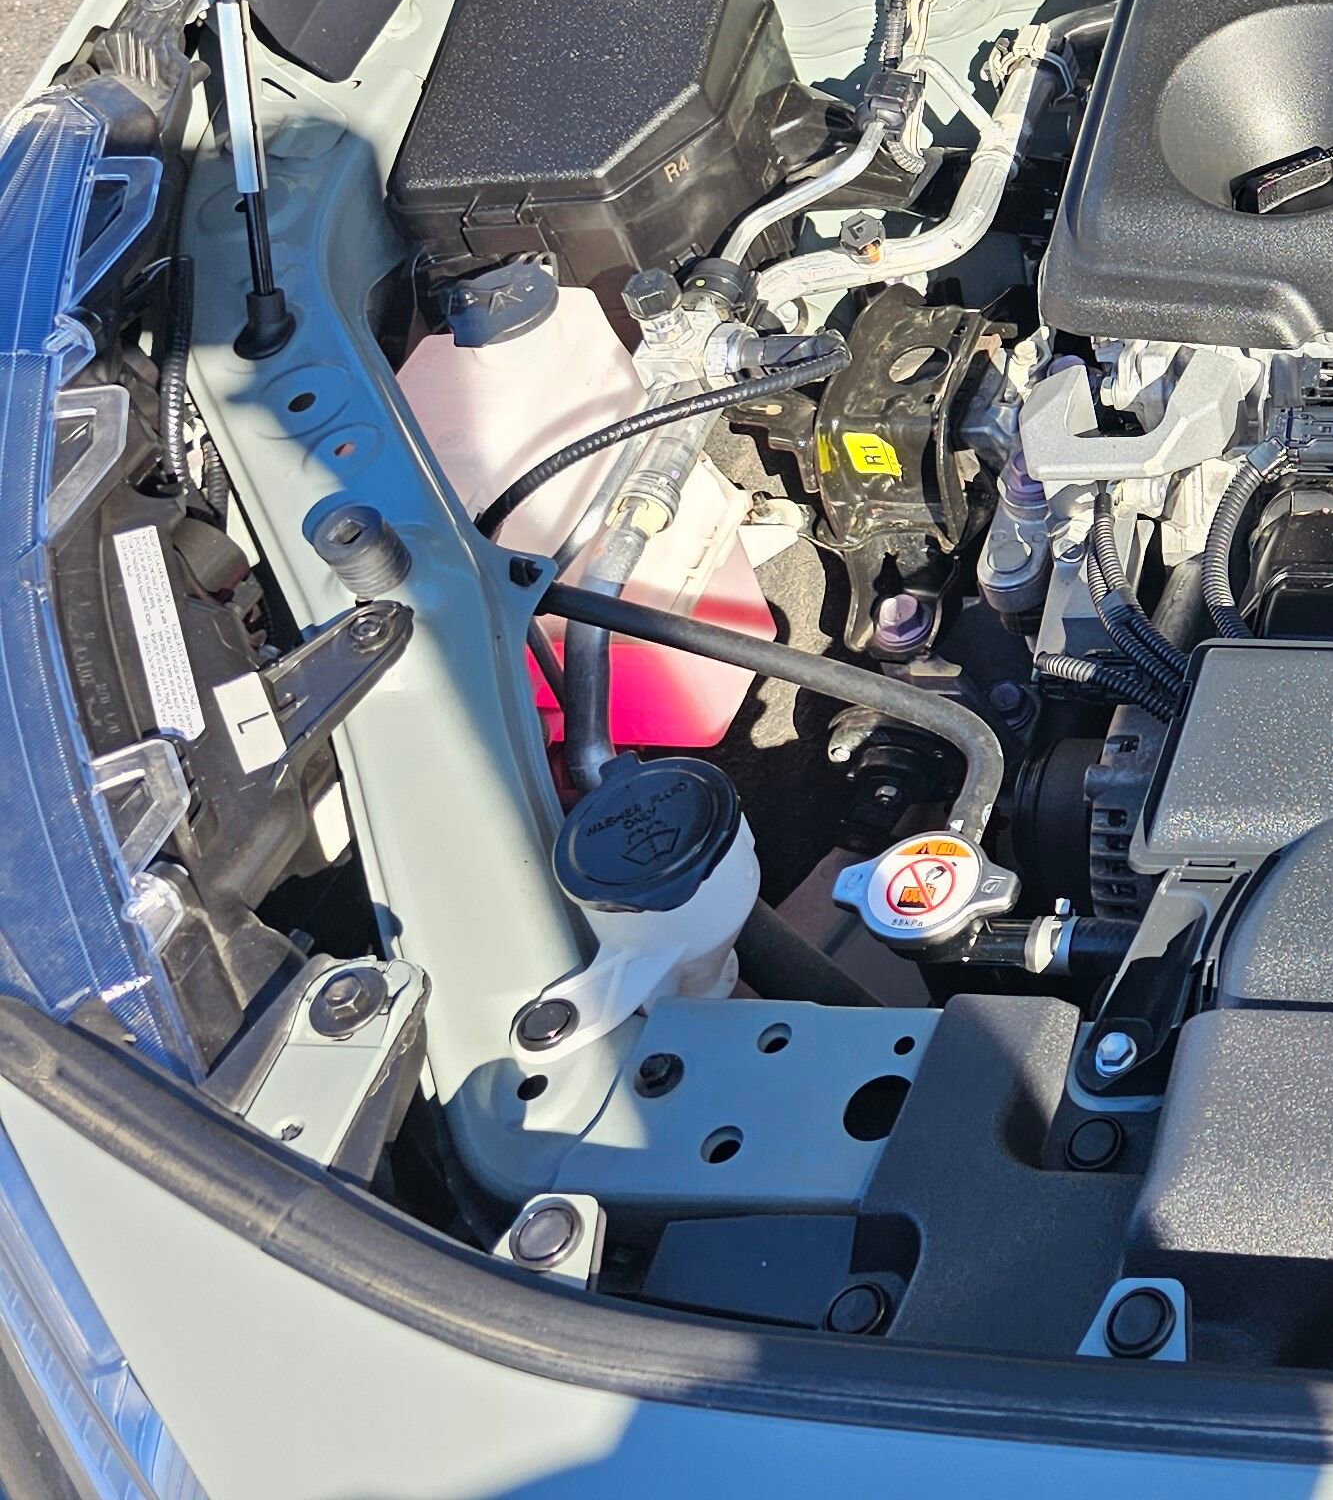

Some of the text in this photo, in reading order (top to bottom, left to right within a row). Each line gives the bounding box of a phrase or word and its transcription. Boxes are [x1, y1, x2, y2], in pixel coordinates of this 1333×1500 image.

[663, 155, 690, 182] R4
[861, 446, 884, 466] R1
[237, 711, 270, 734] L
